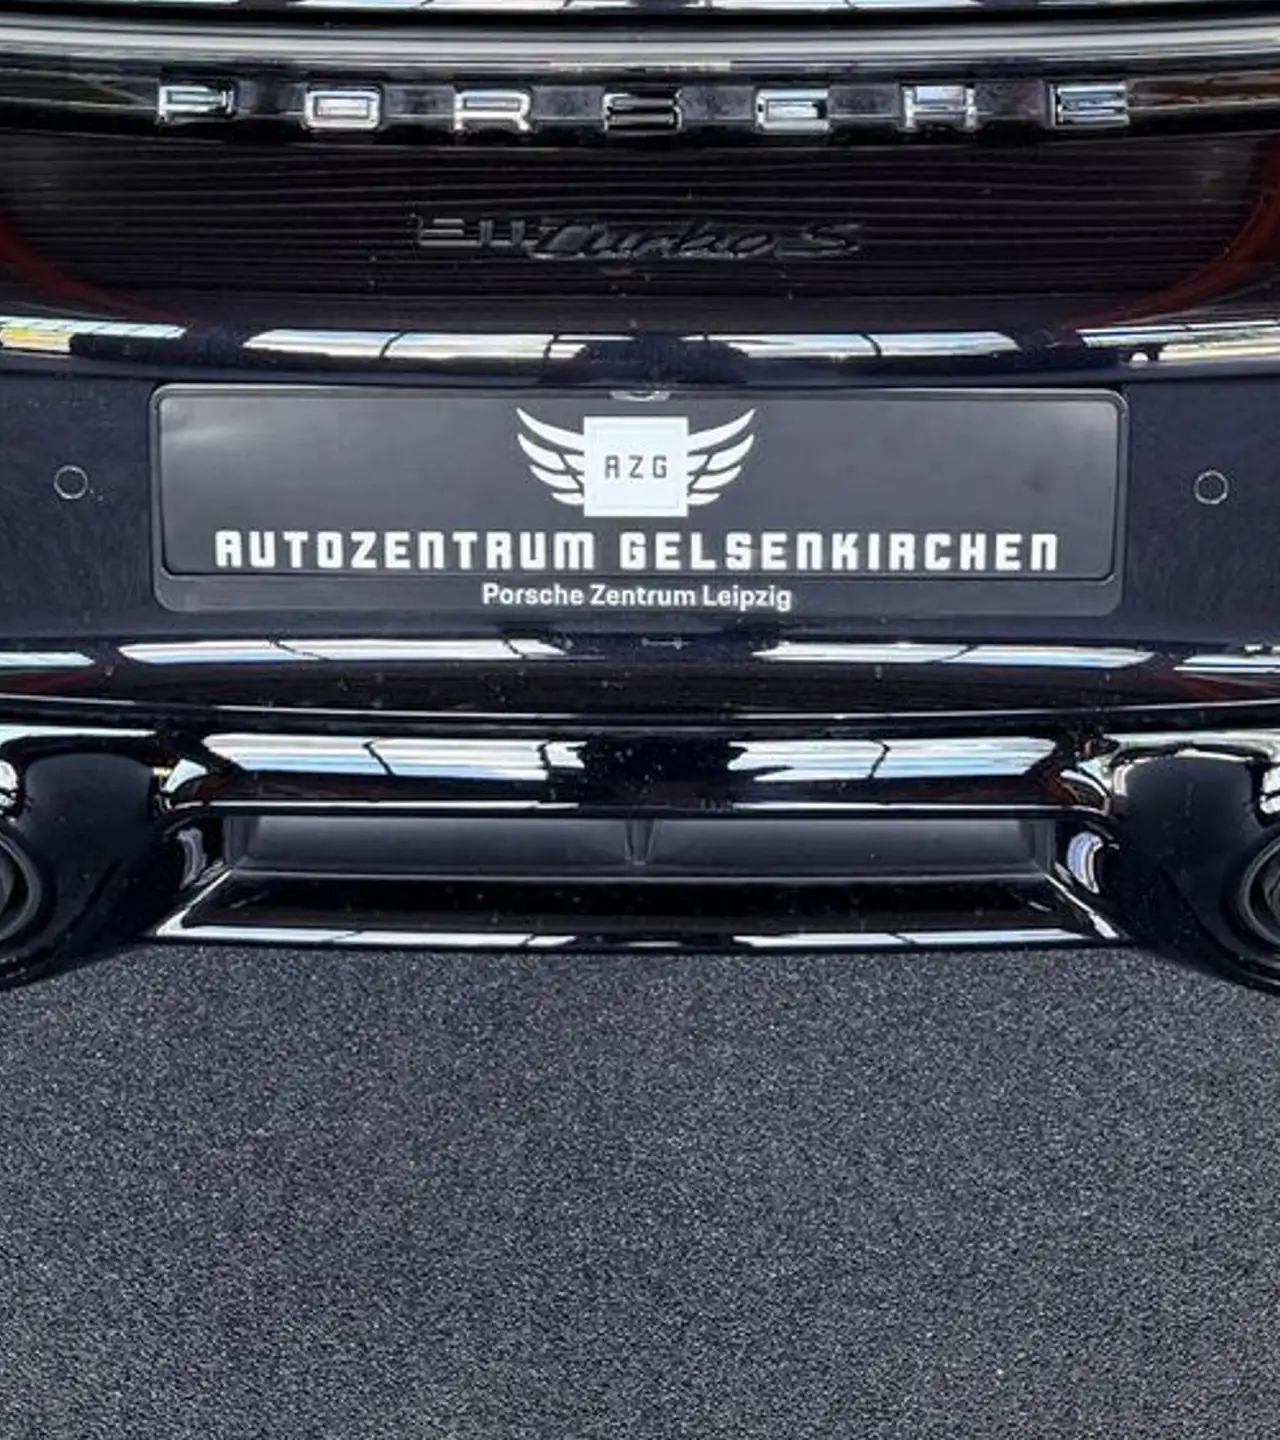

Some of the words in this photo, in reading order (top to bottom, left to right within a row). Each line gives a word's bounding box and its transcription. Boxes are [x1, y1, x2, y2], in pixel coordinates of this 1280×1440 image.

[156, 82, 1131, 133] PORSCHE
[604, 454, 667, 479] AZG
[214, 531, 596, 570] AUTOZENTRUM
[619, 531, 1059, 571] GELSENKIRCHEN
[482, 583, 585, 606] Porsche
[589, 584, 697, 606] Zentrum
[702, 585, 793, 612] Leipzig
